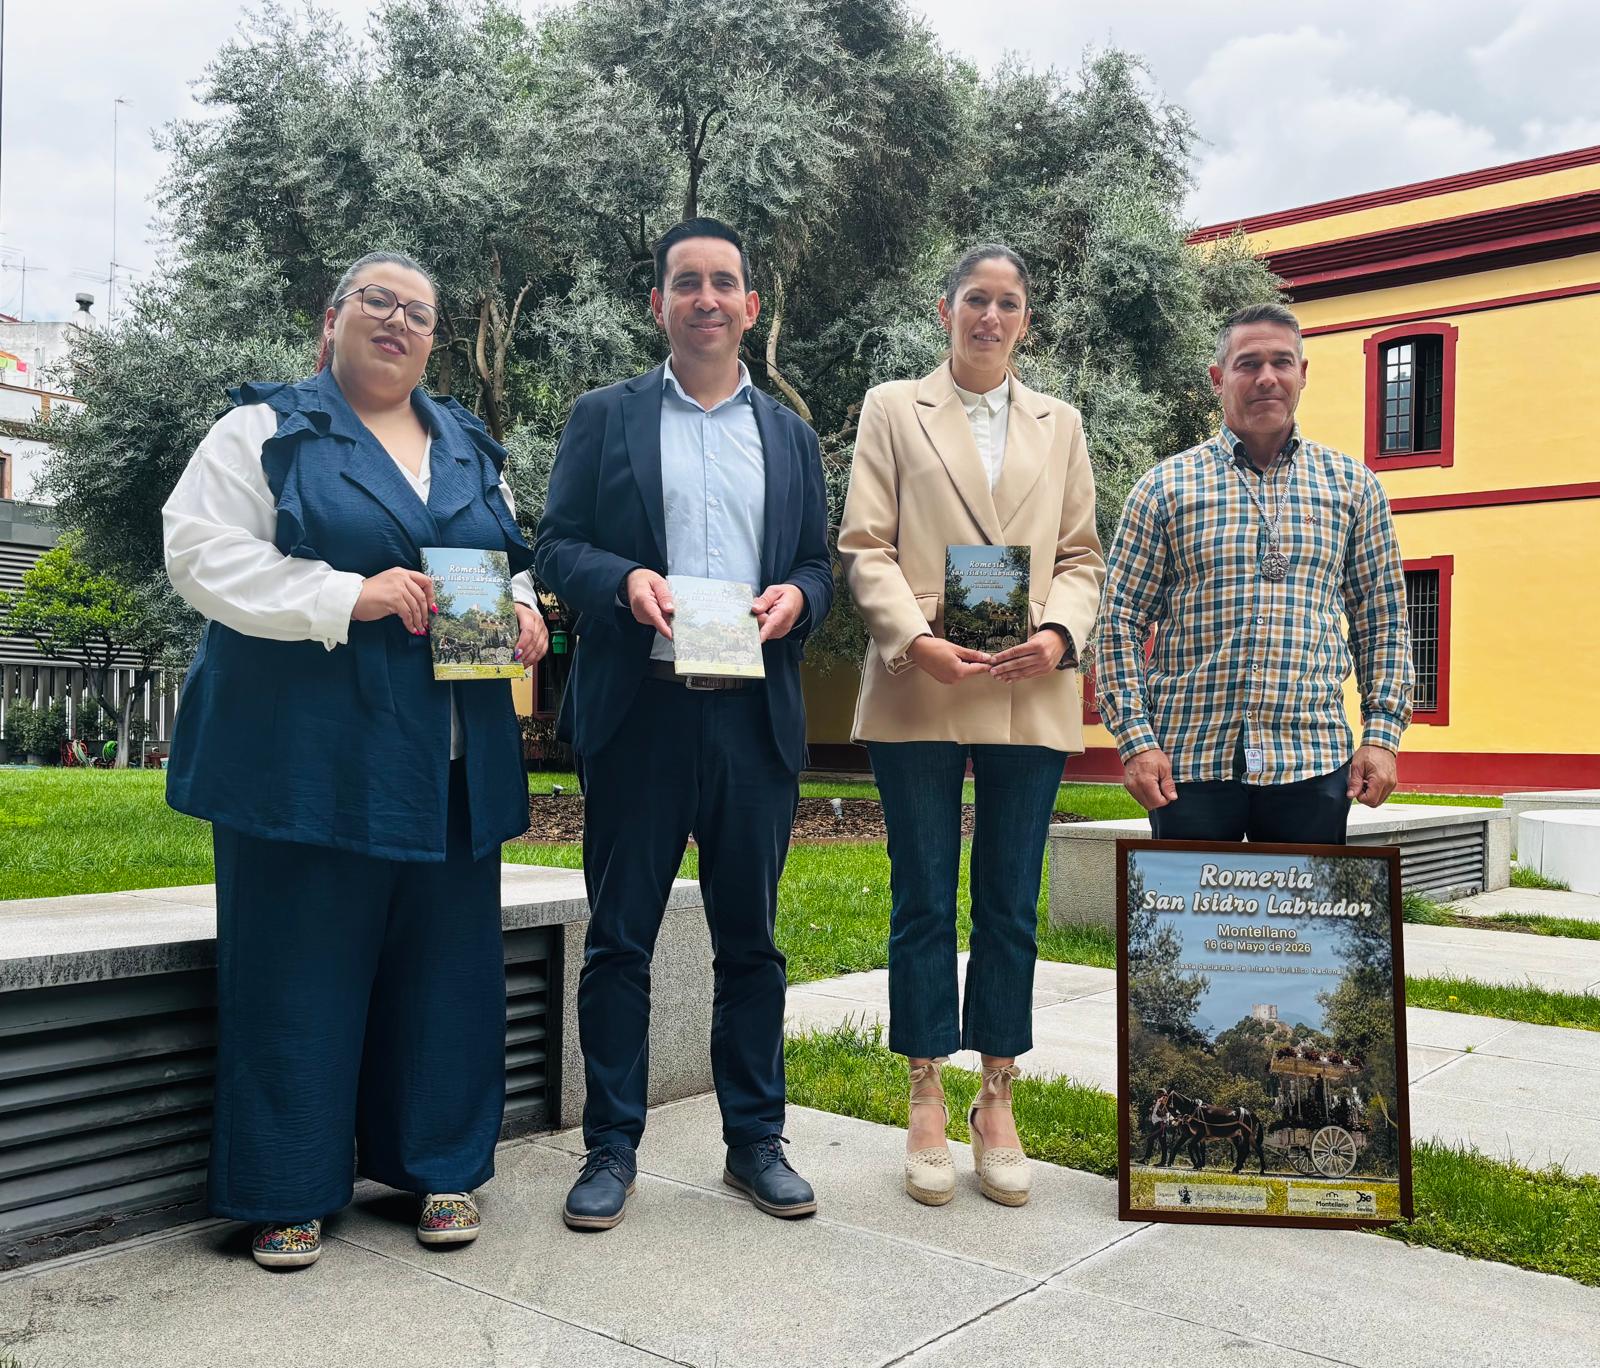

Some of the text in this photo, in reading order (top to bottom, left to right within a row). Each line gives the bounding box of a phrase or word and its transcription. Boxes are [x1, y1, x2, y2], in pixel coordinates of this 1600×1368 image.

[1142, 889, 1372, 917] San Isidro Labrador
[1218, 924, 1297, 939] Montellano
[1205, 940, 1311, 953] 16 de Mayo de 2026
